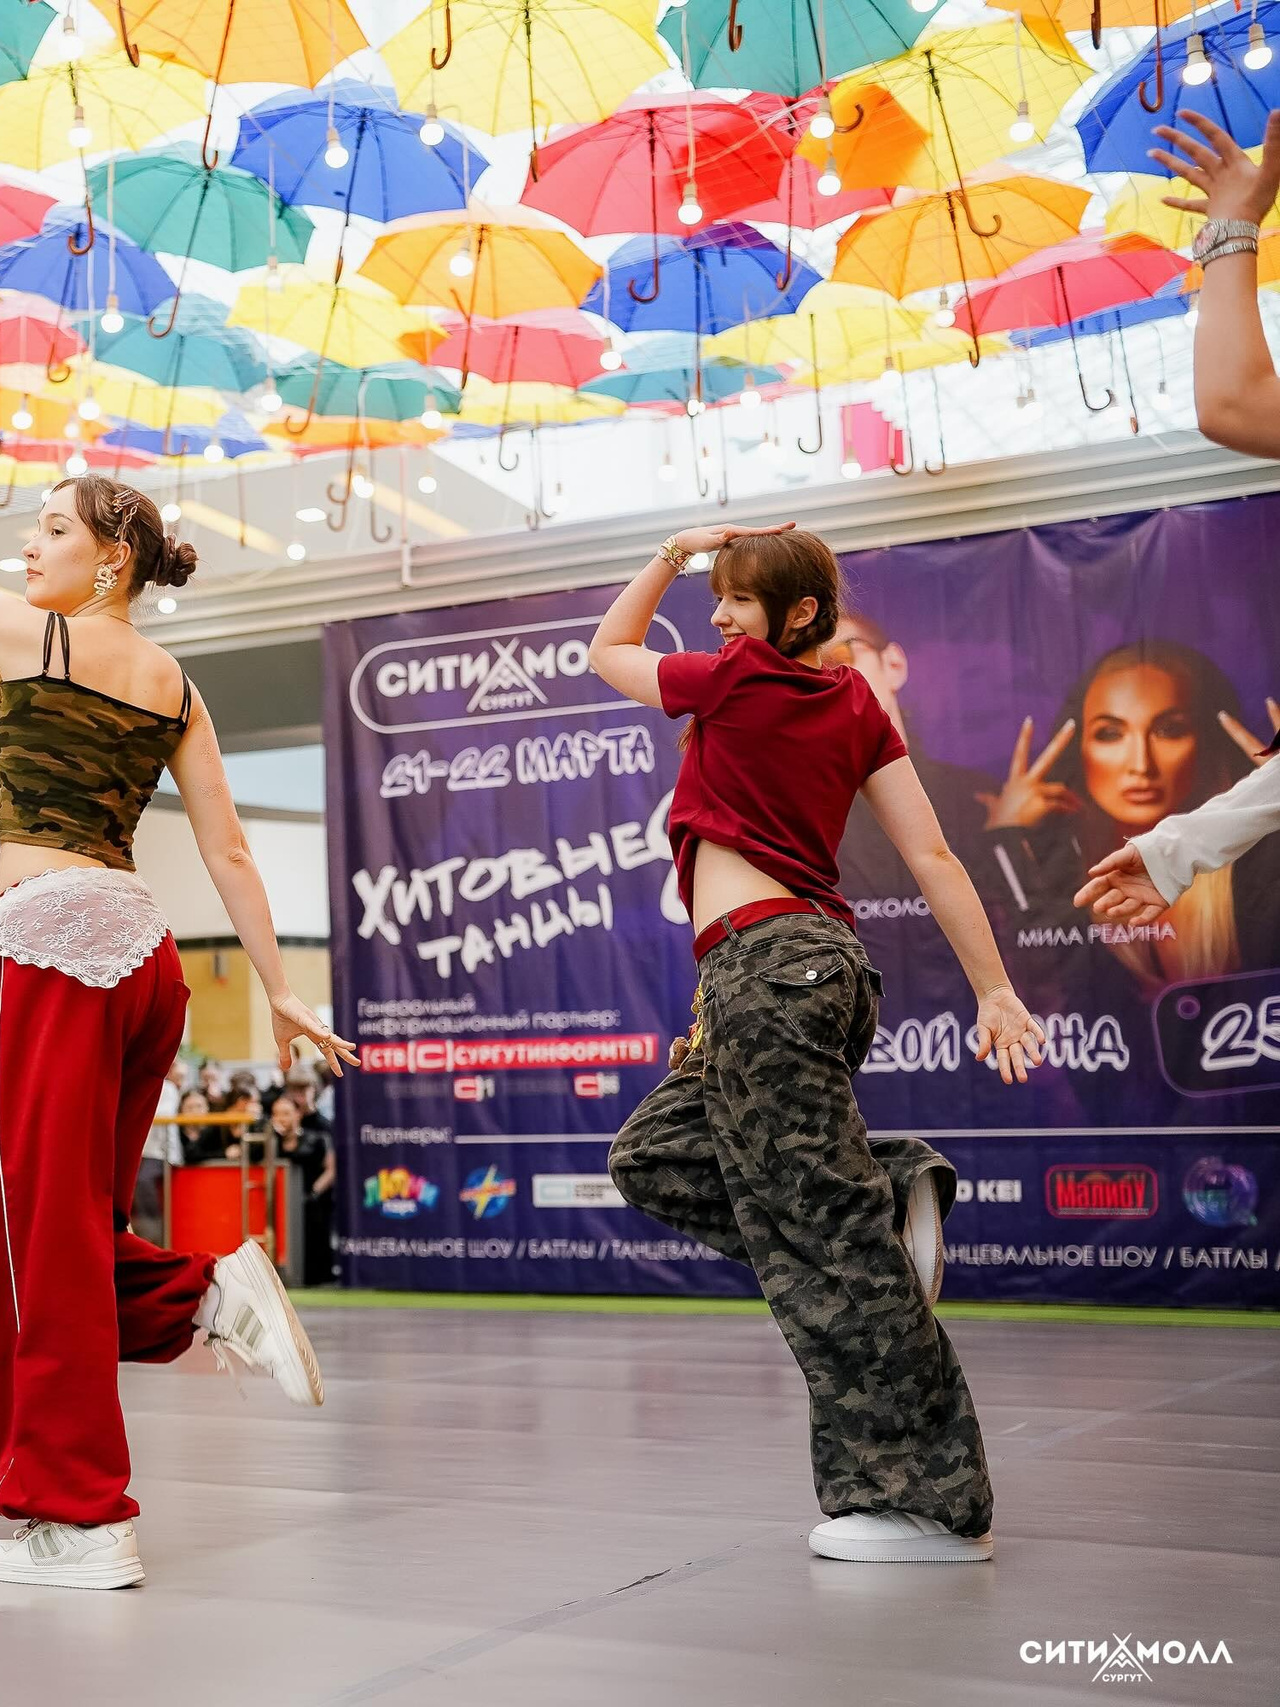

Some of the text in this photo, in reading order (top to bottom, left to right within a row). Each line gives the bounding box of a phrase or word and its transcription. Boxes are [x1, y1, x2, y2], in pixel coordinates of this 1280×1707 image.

[376, 639, 597, 698] СИТИ МО
[379, 725, 655, 799] 21-22 МАРТА
[352, 821, 646, 945] ХИТОВЫЕ
[846, 896, 931, 920] ОКОЛО
[416, 883, 613, 979] ТАНЦЫ
[1017, 920, 1178, 948] МИЛА РЕДИНА
[859, 1011, 960, 1073] ВОЙ
[1099, 1246, 1157, 1268] ШОУ
[1180, 1247, 1268, 1269] БАТТЛЫ
